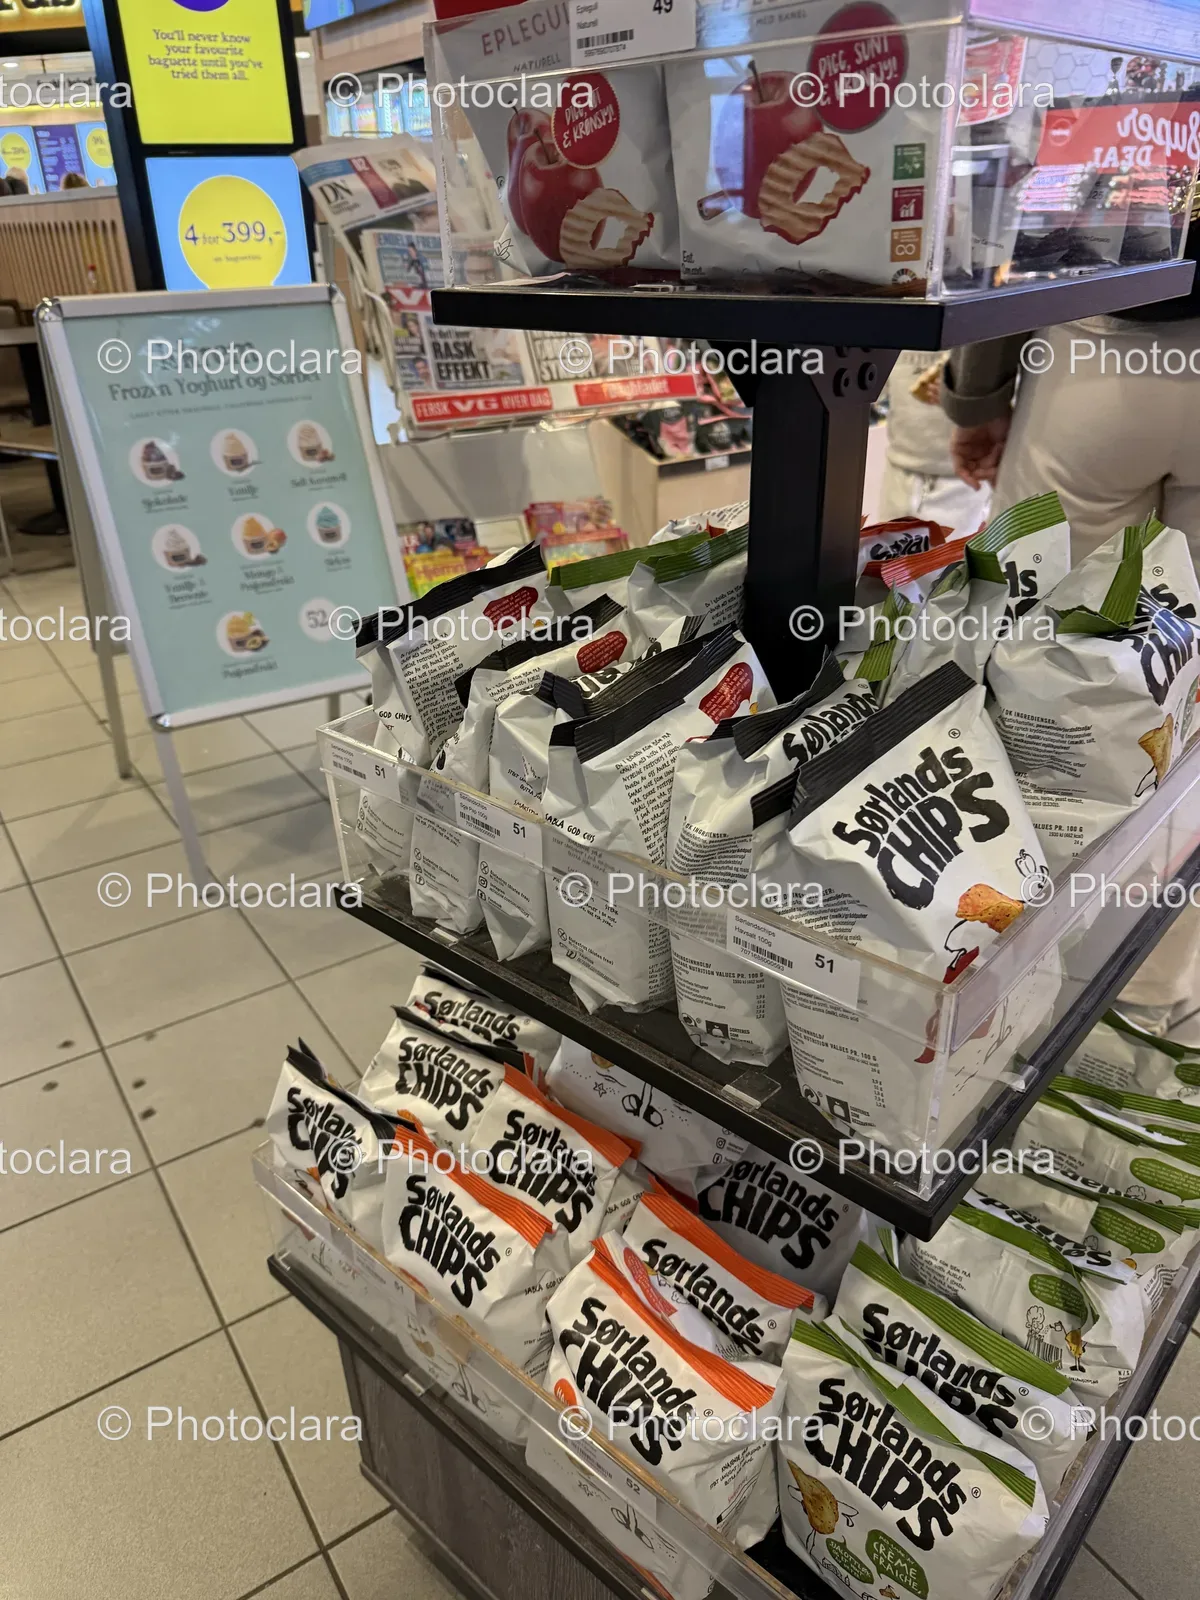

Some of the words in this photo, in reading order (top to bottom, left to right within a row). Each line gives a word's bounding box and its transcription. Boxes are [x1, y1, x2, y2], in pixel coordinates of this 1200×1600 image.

[652, 0, 673, 14] 49
[188, 33, 218, 43] never
[221, 32, 251, 43] know
[165, 45, 191, 56] your
[194, 43, 244, 56] favourite
[148, 54, 198, 69] baguette
[201, 57, 227, 68] until
[229, 58, 263, 71] you've
[171, 68, 198, 79] tried
[201, 69, 229, 80] them
[513, 53, 561, 73] NATURELL
[318, 180, 354, 203] DN
[184, 223, 199, 246] 4
[222, 220, 282, 247] 399,-
[431, 341, 475, 360] RASK
[437, 360, 491, 382] EFFEKT
[174, 376, 243, 399] Yoghurt
[245, 375, 268, 391] og
[414, 402, 451, 419] FERSK
[452, 398, 500, 413] VG
[529, 390, 552, 408] DAG
[379, 711, 392, 720] GOD
[394, 712, 413, 724] CHIPS
[374, 764, 386, 779] 51
[832, 745, 976, 859] Sørlands
[513, 822, 526, 839] 51
[545, 813, 565, 829] SABLA
[567, 825, 581, 836] GOD
[1066, 825, 1078, 833] 100
[876, 771, 1011, 910] CHIPS
[734, 926, 757, 940] Havsalt
[757, 936, 773, 948] 100g
[814, 953, 835, 974] 51
[423, 990, 521, 1042] Sørlands
[398, 1035, 495, 1100] Sørlands
[860, 1051, 871, 1061] 100
[394, 1061, 483, 1132] CHIPS
[503, 1108, 599, 1198] Sørlands
[486, 1138, 594, 1233] CHIPS
[604, 1203, 620, 1218] ABLA
[405, 1174, 500, 1273] Sørlands
[697, 1178, 831, 1270] CHIPS
[398, 1203, 488, 1309] CHIPS
[640, 1237, 766, 1346] Sørlands
[572, 1296, 698, 1423] Sørlands
[862, 1302, 1020, 1409] Sørlands
[558, 1326, 684, 1467] CHIPS
[818, 1376, 968, 1517] Sørlands
[626, 1477, 641, 1495] 52
[803, 1411, 955, 1552] CHIPS
